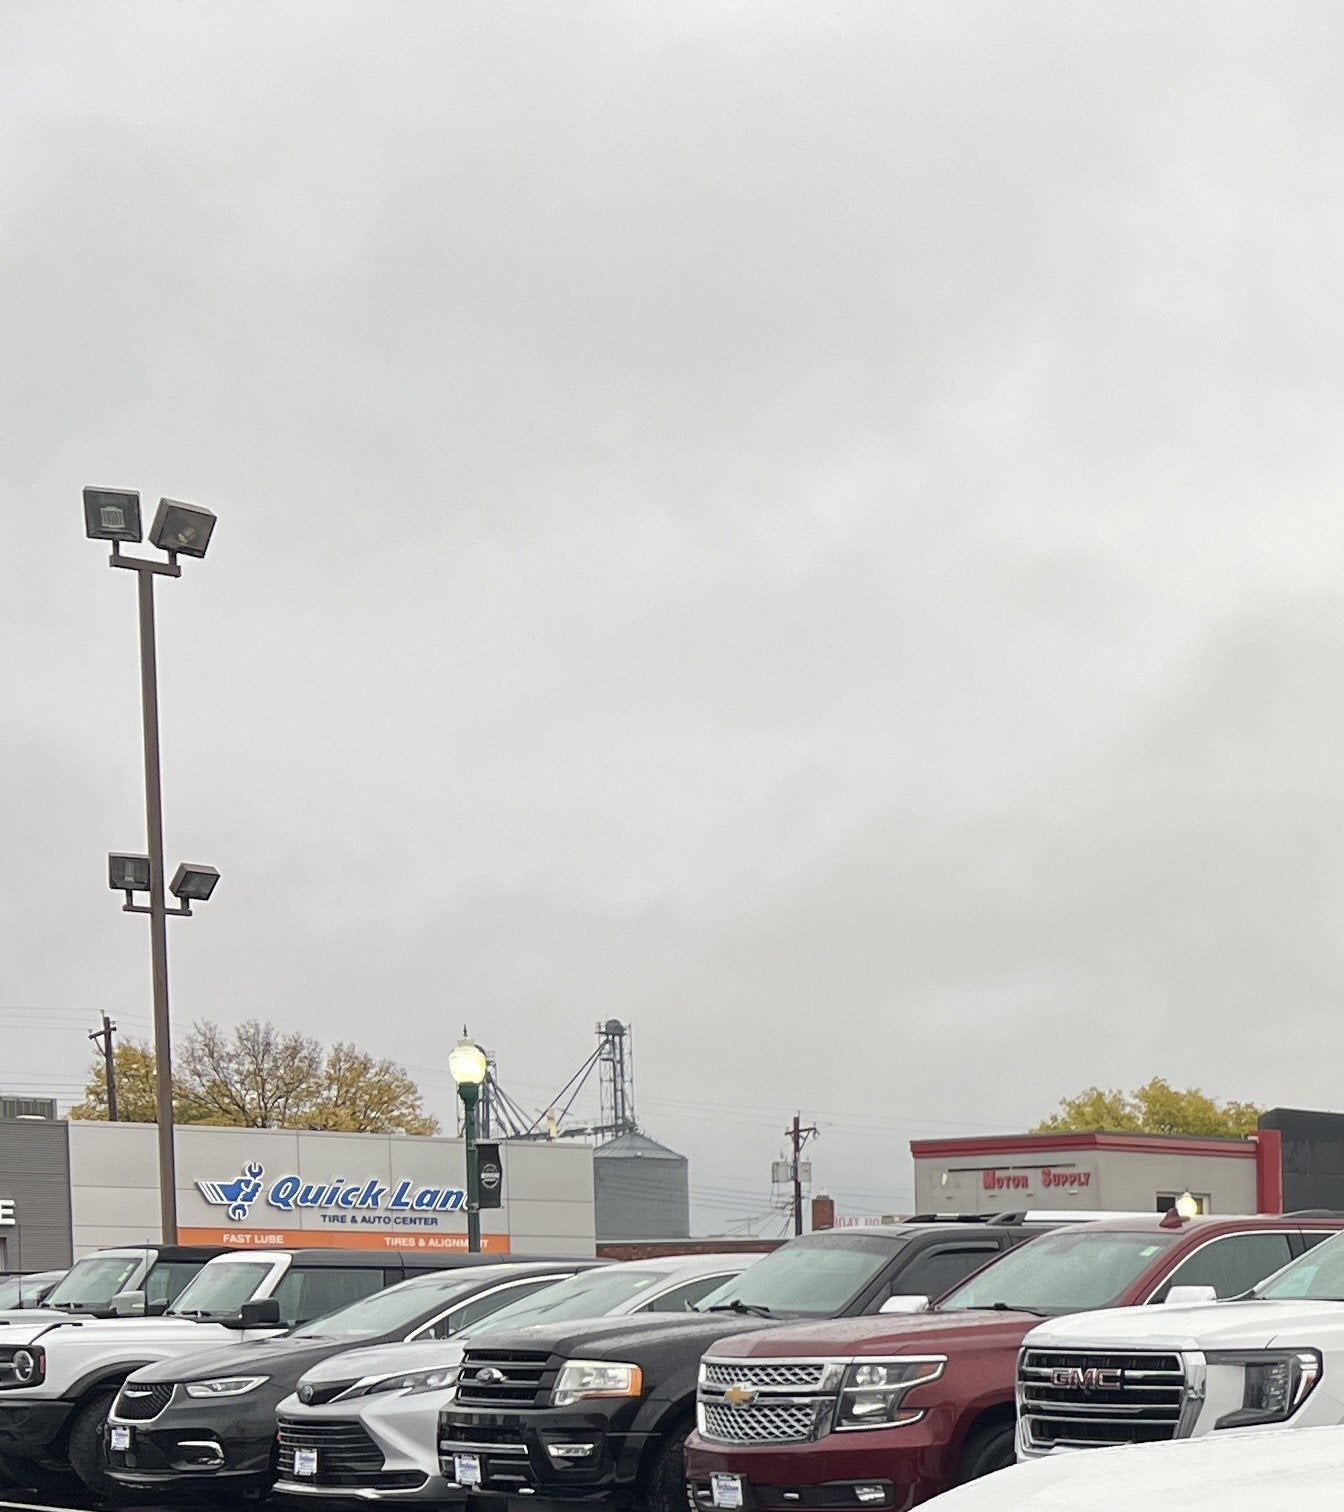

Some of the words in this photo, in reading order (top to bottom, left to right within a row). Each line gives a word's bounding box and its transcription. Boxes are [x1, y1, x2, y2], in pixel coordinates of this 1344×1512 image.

[269, 1176, 388, 1211] Quick
[389, 1180, 469, 1212] Lan
[321, 1214, 347, 1223] TIRE
[350, 1215, 358, 1224] &
[361, 1216, 391, 1225] AUTO
[393, 1217, 438, 1226] CENTER
[223, 1233, 252, 1243] FAST
[254, 1234, 284, 1244] LUBE
[384, 1236, 416, 1247] TIRES
[418, 1237, 427, 1247] &
[429, 1238, 489, 1248] ALIGNMT
[1050, 1367, 1121, 1390] GMC
